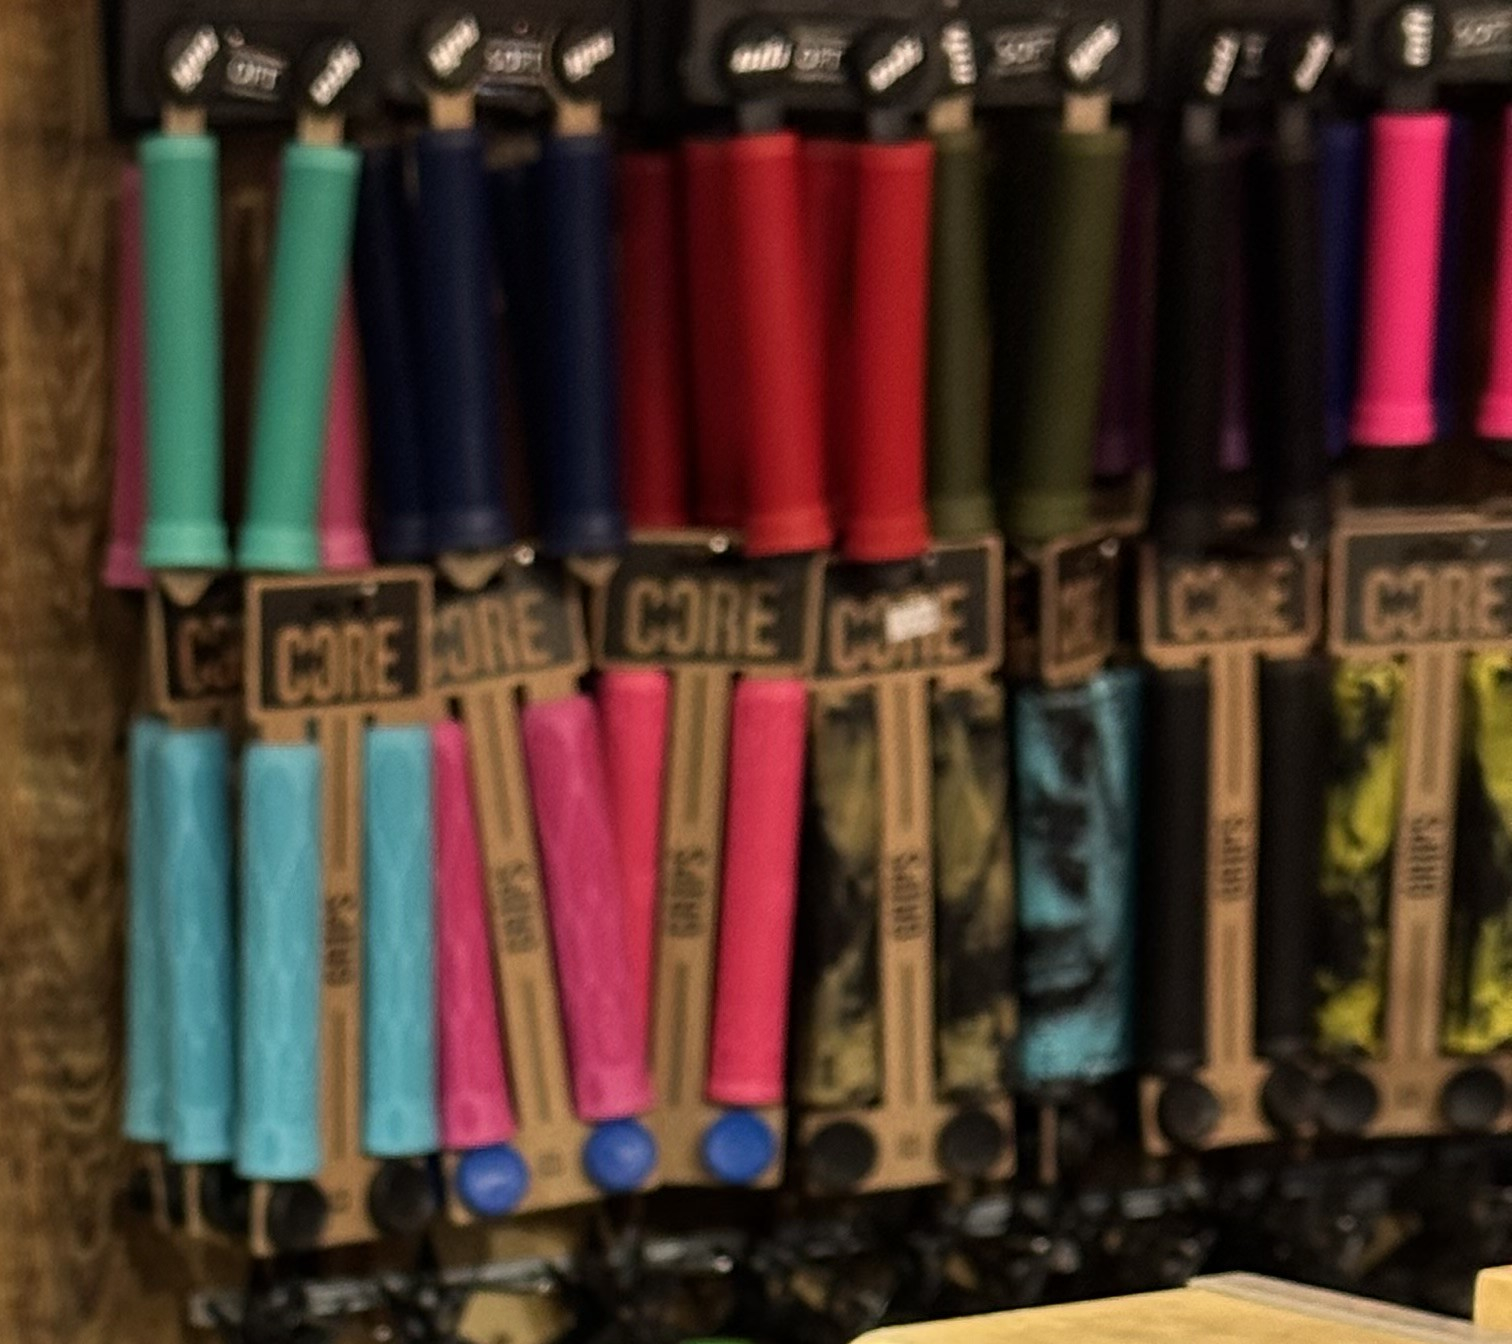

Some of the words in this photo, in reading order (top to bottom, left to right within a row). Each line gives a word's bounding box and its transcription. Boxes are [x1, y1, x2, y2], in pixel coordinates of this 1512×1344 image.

[433, 588, 554, 681] ORE
[624, 577, 783, 658] CORE
[1361, 562, 1506, 643] CORE
[276, 618, 403, 702] CORE
